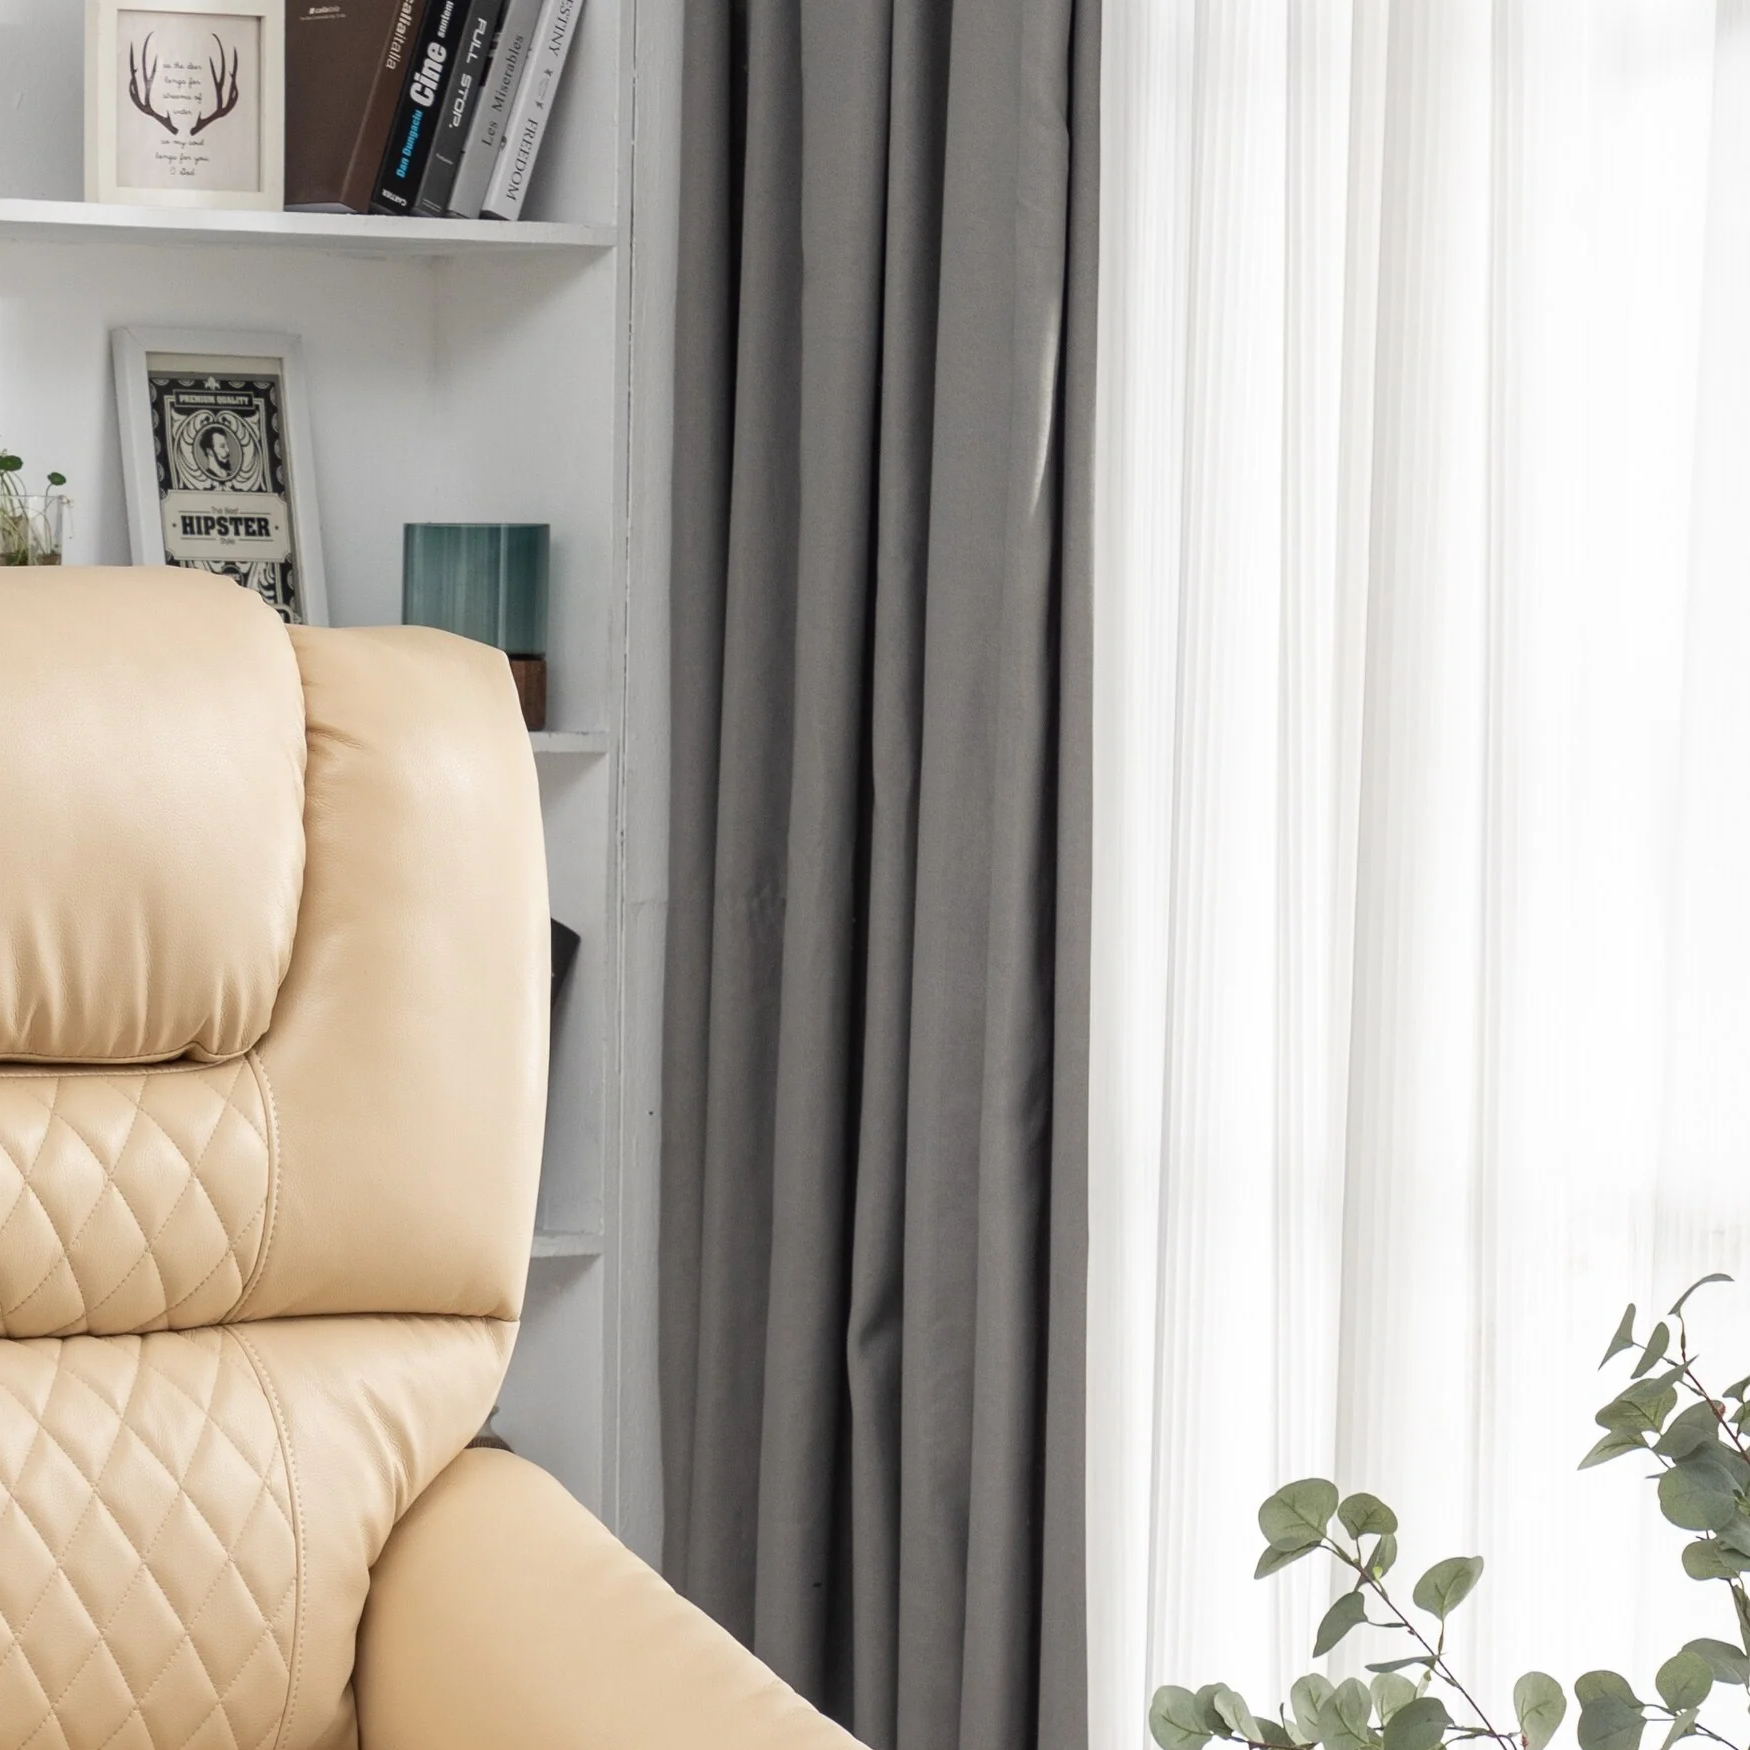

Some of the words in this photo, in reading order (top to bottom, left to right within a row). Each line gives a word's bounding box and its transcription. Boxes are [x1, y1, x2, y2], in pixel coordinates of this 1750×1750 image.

[466, 17, 487, 63] FULL
[410, 42, 447, 107] Cine
[481, 121, 498, 147] Les
[491, 35, 524, 113] Miserables
[449, 73, 472, 129] STOP.
[402, 109, 424, 157] Dungaciu
[395, 159, 411, 178] Dan
[505, 118, 539, 202] FREEDOM
[179, 394, 215, 404] PREMIUM
[216, 395, 249, 405] QUALITY
[180, 515, 271, 537] HIPSTER
